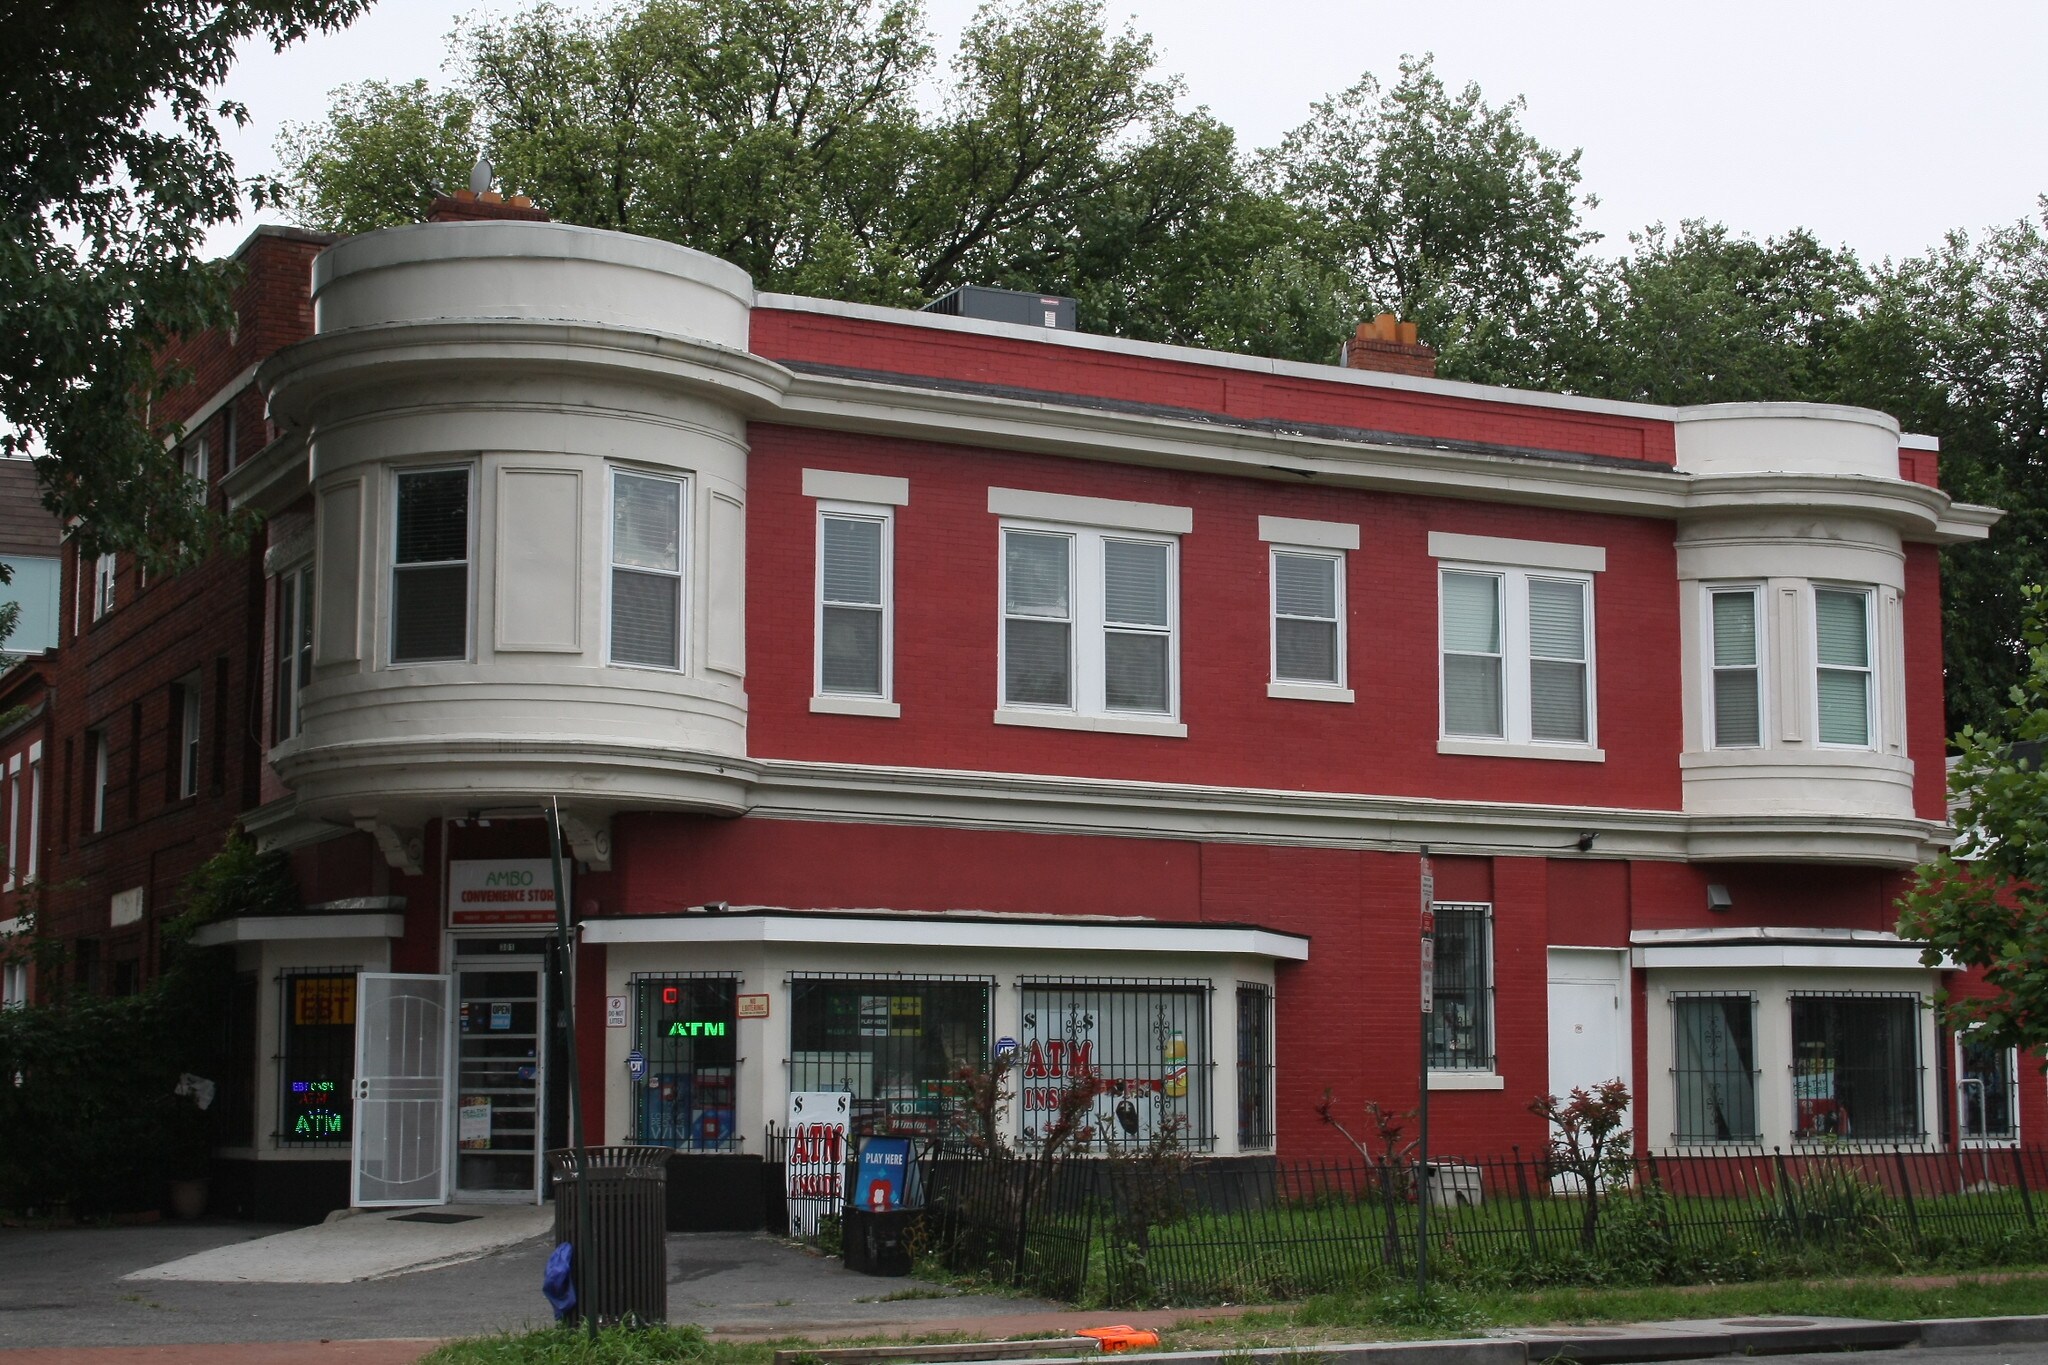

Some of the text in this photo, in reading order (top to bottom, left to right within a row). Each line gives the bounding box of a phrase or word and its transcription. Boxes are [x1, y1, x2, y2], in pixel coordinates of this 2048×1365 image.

[486, 870, 533, 886] AMBO
[461, 889, 557, 903] CONVENIENCE STOR
[301, 997, 350, 1020] EBT
[492, 1005, 511, 1015] OPEN
[609, 1017, 623, 1025] LITTER
[668, 1022, 725, 1036] ATM
[1023, 1038, 1094, 1079] ATM
[629, 1061, 643, 1072] DT
[891, 1102, 920, 1114] KOOL
[295, 1114, 342, 1132] ATM
[650, 1127, 685, 1139] WIN
[790, 1123, 845, 1165] ATM
[865, 1152, 903, 1166] PLAY HERE
